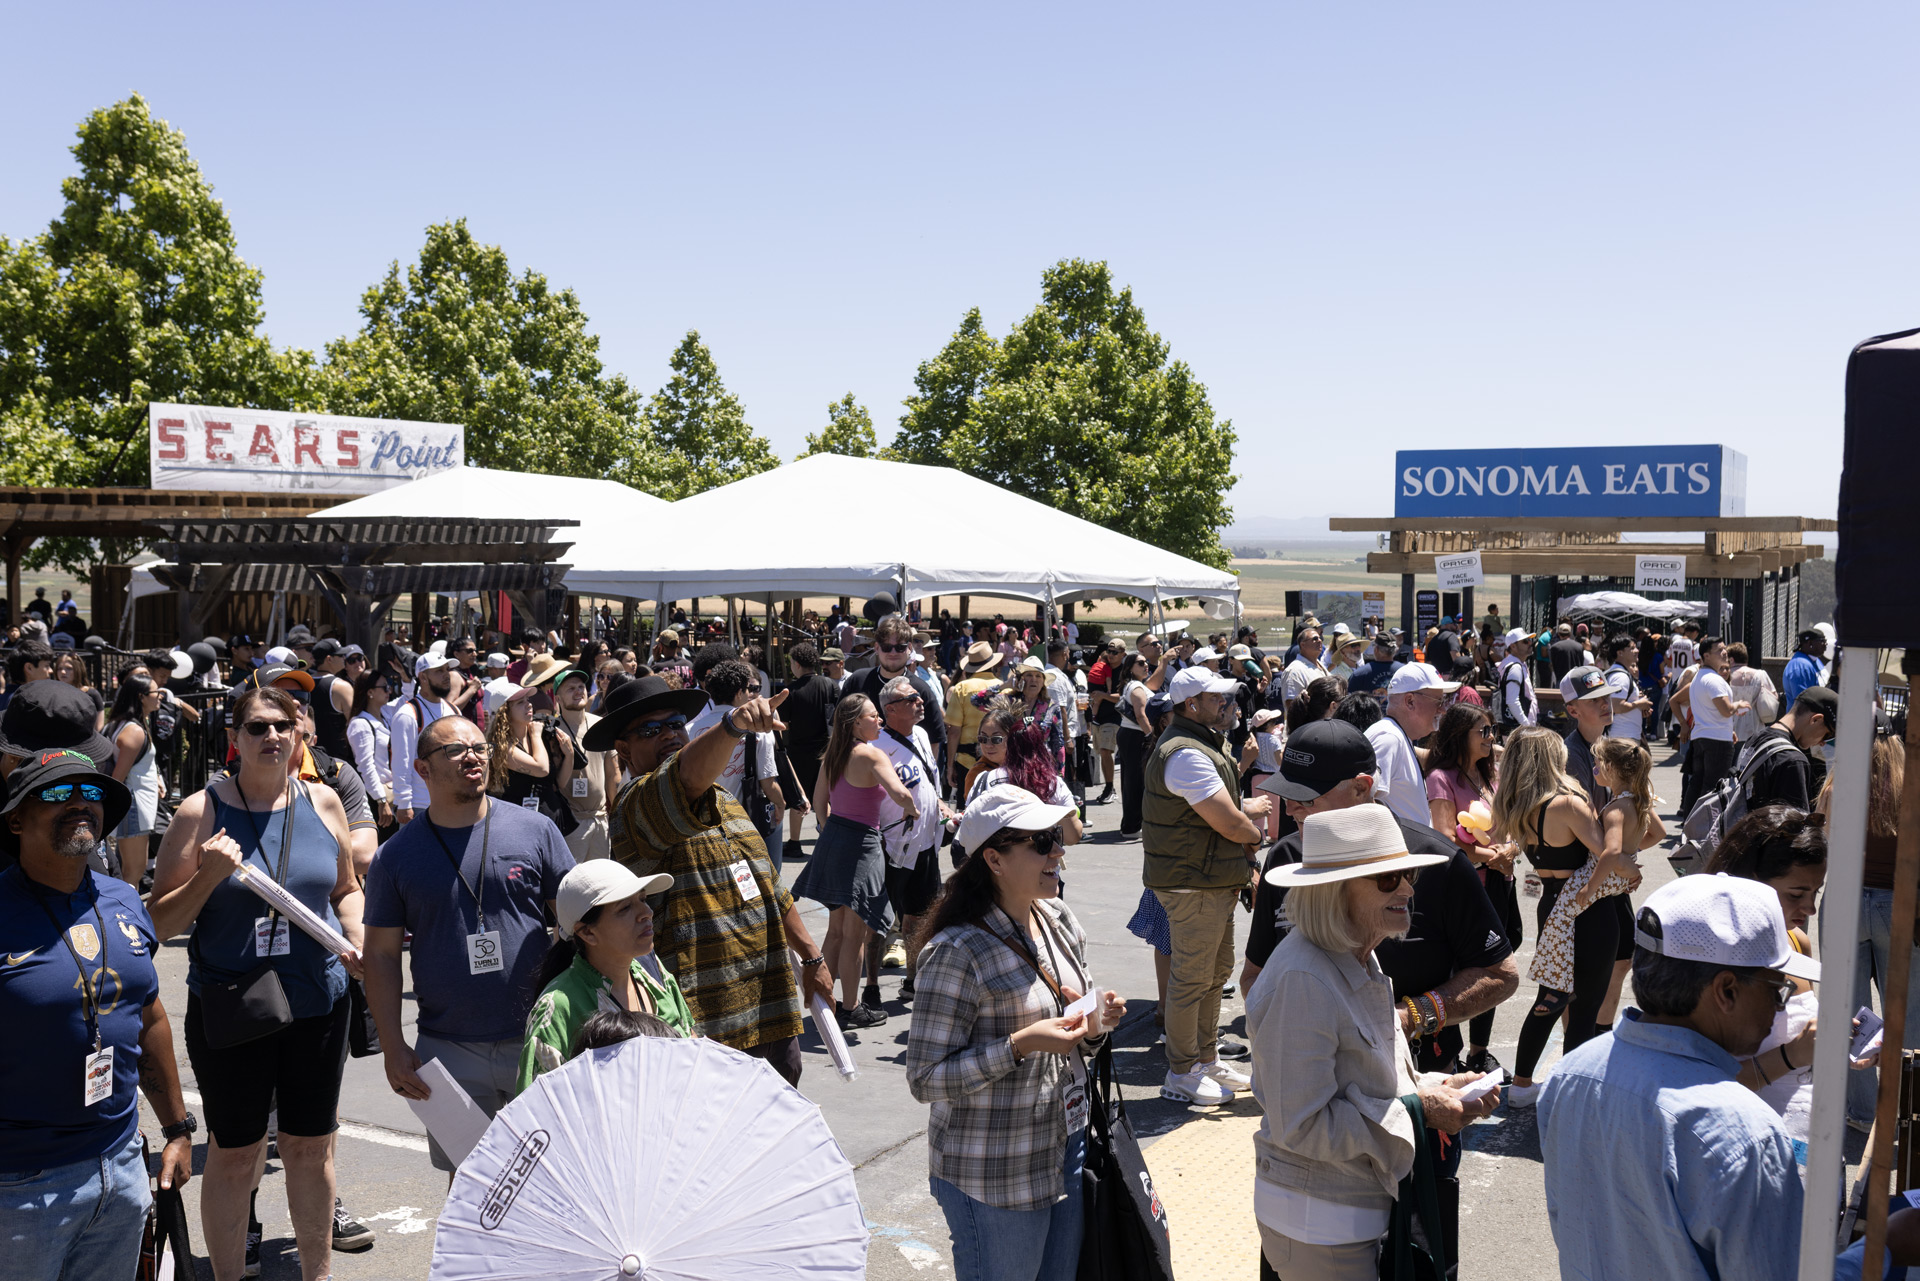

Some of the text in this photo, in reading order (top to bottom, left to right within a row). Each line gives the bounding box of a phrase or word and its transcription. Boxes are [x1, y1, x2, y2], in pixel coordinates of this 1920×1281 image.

[157, 418, 361, 468] SEARS
[370, 430, 458, 470] Point
[1402, 462, 1711, 497] SONOMA EATS
[1447, 577, 1475, 586] PAINTING
[1640, 577, 1679, 587] JENGA
[1673, 651, 1688, 668] 10
[477, 1130, 530, 1211] FAMILY DEALERSHIPS
